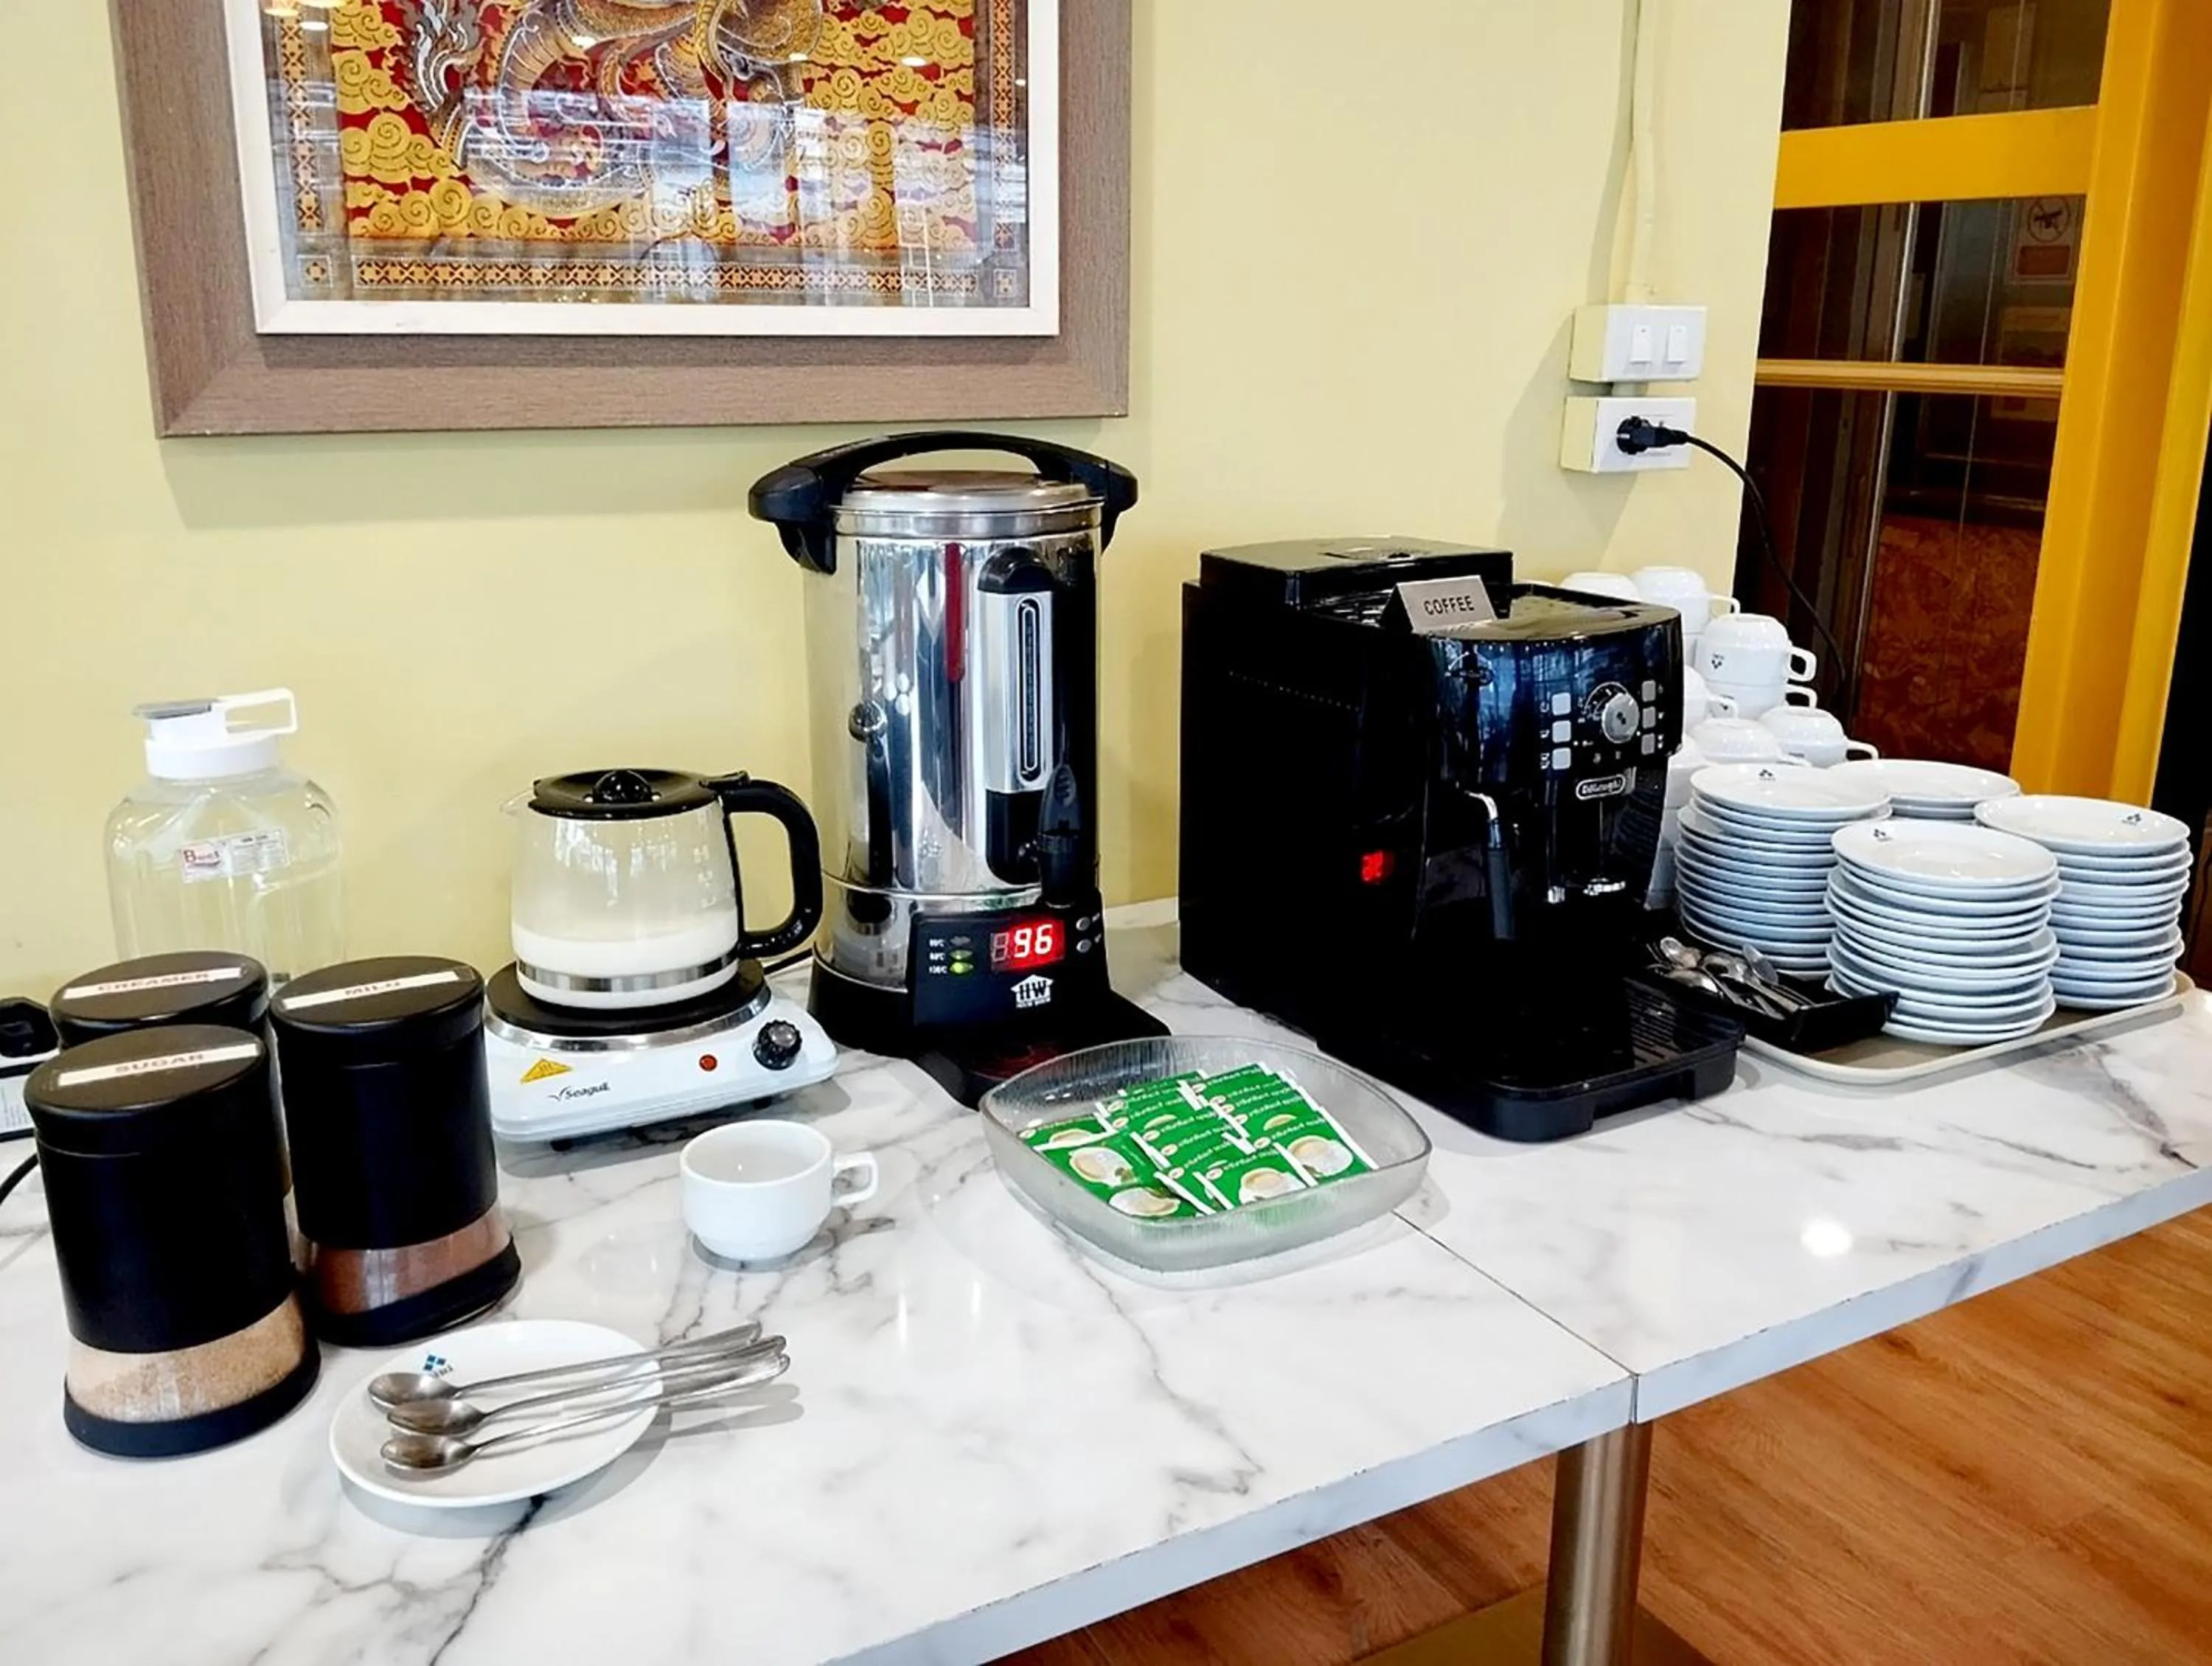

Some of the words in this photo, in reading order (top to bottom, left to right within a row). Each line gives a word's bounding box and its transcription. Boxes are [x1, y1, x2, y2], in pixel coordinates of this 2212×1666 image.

[1423, 595, 1475, 616] COFFEE
[1014, 923, 1054, 958] 96
[114, 1053, 204, 1074] SUGAR
